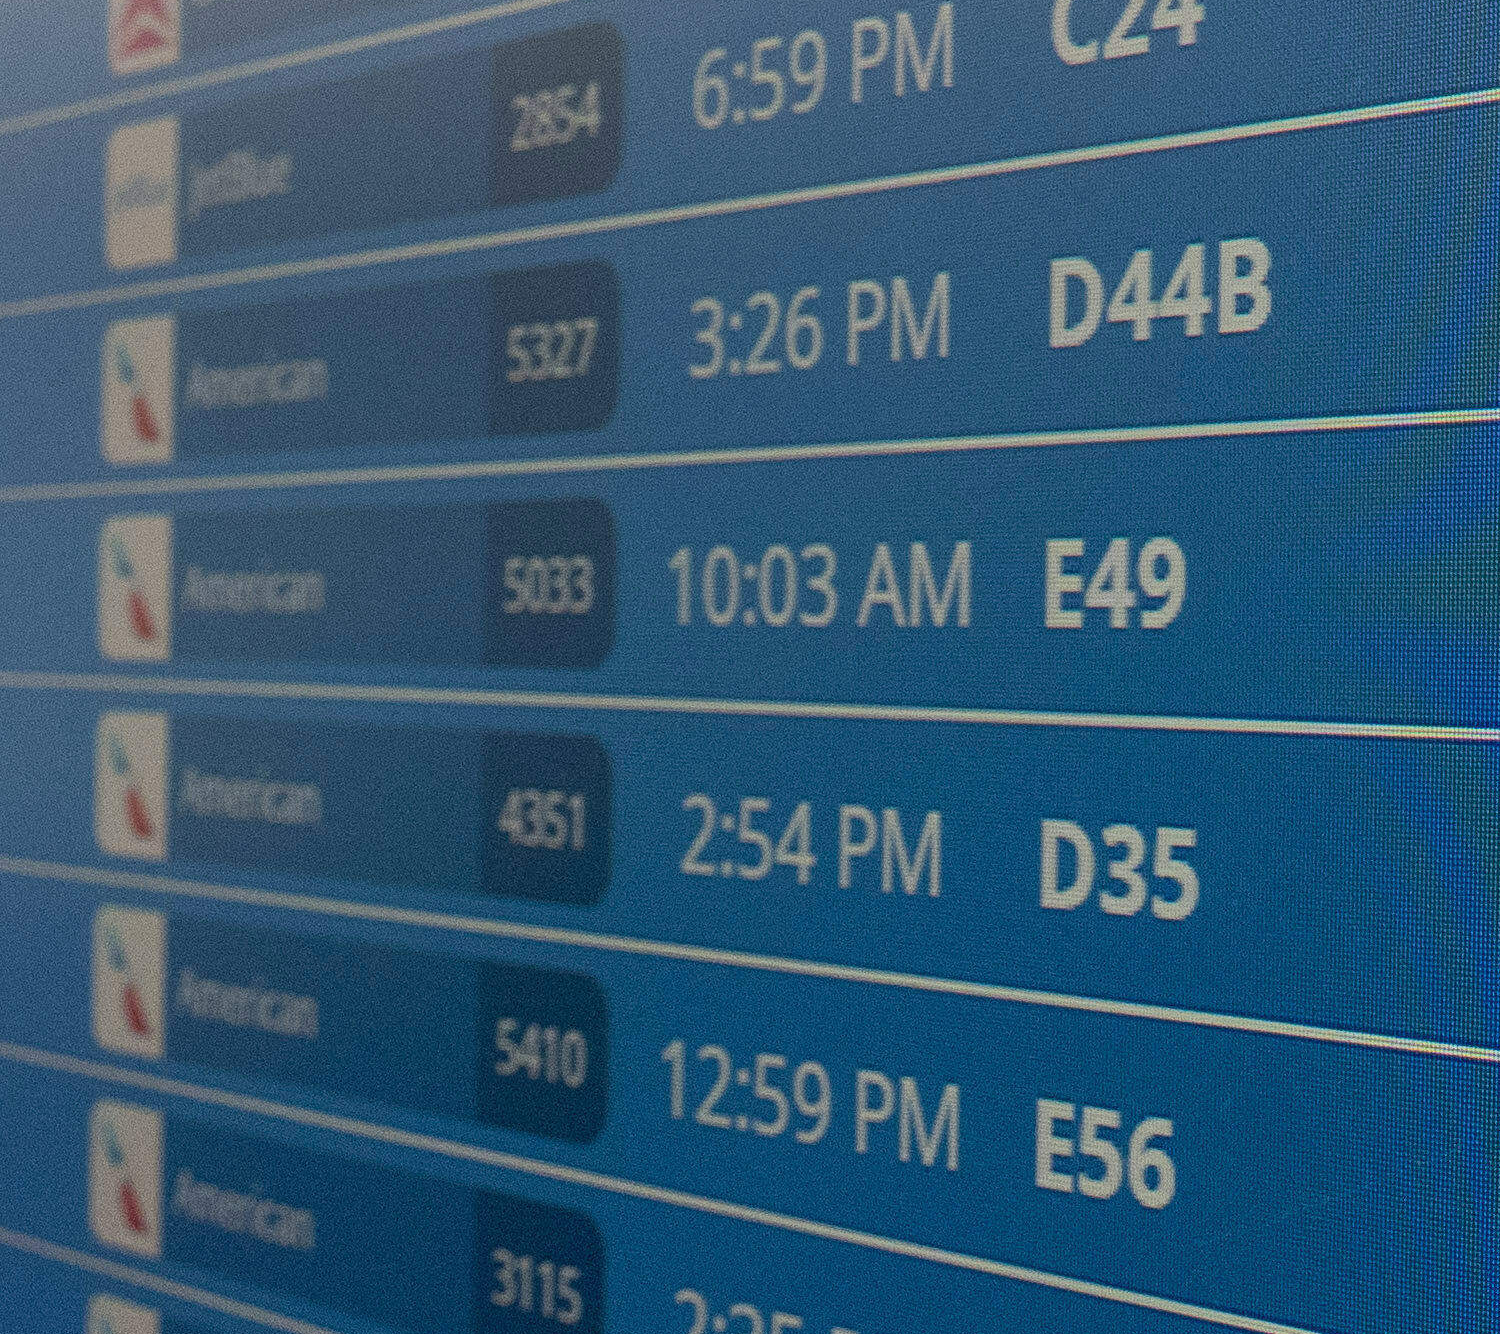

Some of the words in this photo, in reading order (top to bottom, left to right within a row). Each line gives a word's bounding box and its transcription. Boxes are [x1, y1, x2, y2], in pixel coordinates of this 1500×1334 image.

[510, 82, 601, 153] 2854
[692, 30, 825, 130] 6:59
[851, 2, 955, 103] PM
[188, 355, 330, 409] American
[506, 317, 597, 383] 5327
[688, 285, 823, 378] 3:26
[847, 272, 950, 366] PM
[1050, 235, 1273, 349] D44B
[181, 564, 325, 614] American
[501, 554, 596, 616] 5033
[667, 543, 838, 628] 10:03
[857, 540, 971, 628] AM
[1045, 535, 1188, 629] E49
[181, 767, 322, 827] American
[498, 788, 587, 852] 4351
[681, 792, 816, 886] 2:54
[838, 804, 942, 897] PM
[1039, 818, 1202, 921] D35
[177, 967, 321, 1042] American
[495, 1016, 588, 1090] 5410
[661, 1039, 832, 1144] 12:59
[855, 1069, 961, 1171] PM
[1034, 1097, 1177, 1210] E56
[172, 1168, 317, 1252] American
[490, 1248, 584, 1327] 3115
